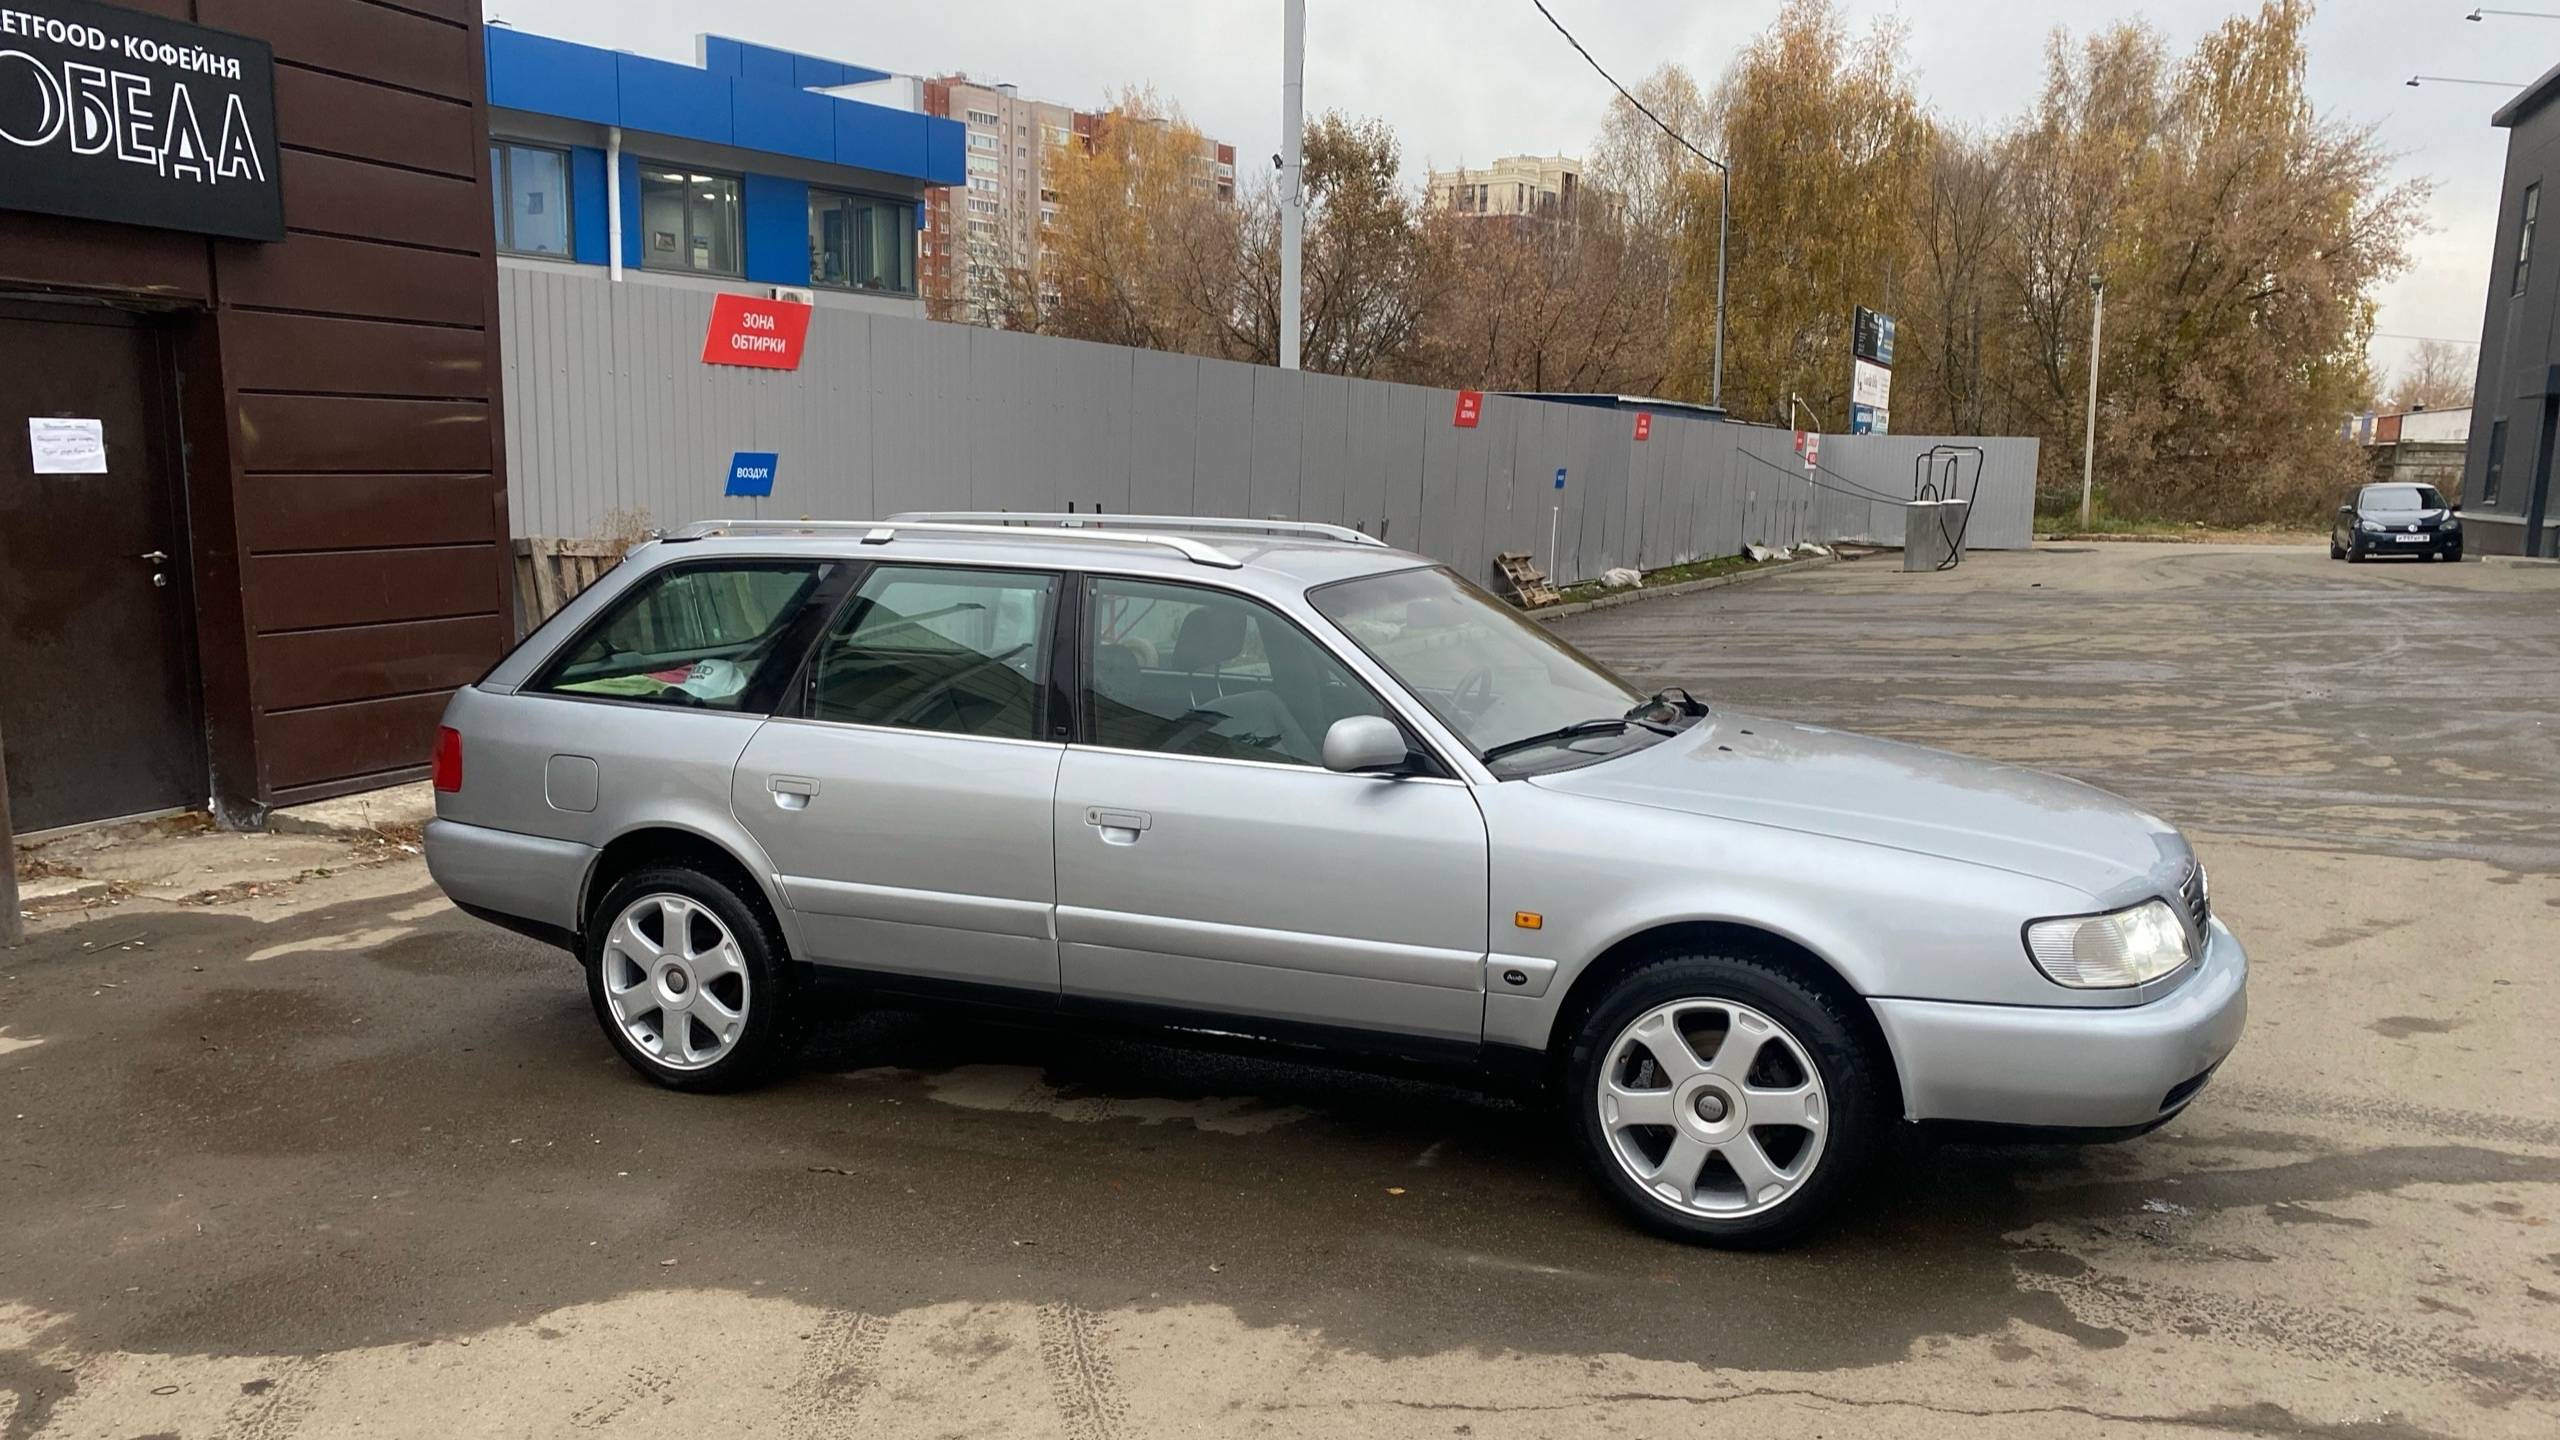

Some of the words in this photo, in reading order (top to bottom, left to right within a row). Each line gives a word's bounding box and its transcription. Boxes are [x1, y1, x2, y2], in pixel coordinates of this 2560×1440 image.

[0, 9, 105, 51] ETFOOD
[124, 35, 241, 80] КОФЕЙНЯ
[742, 312, 775, 330] ЗОНА
[731, 333, 786, 353] ОБТИРКИ
[736, 466, 769, 480] ВОЗДУХ
